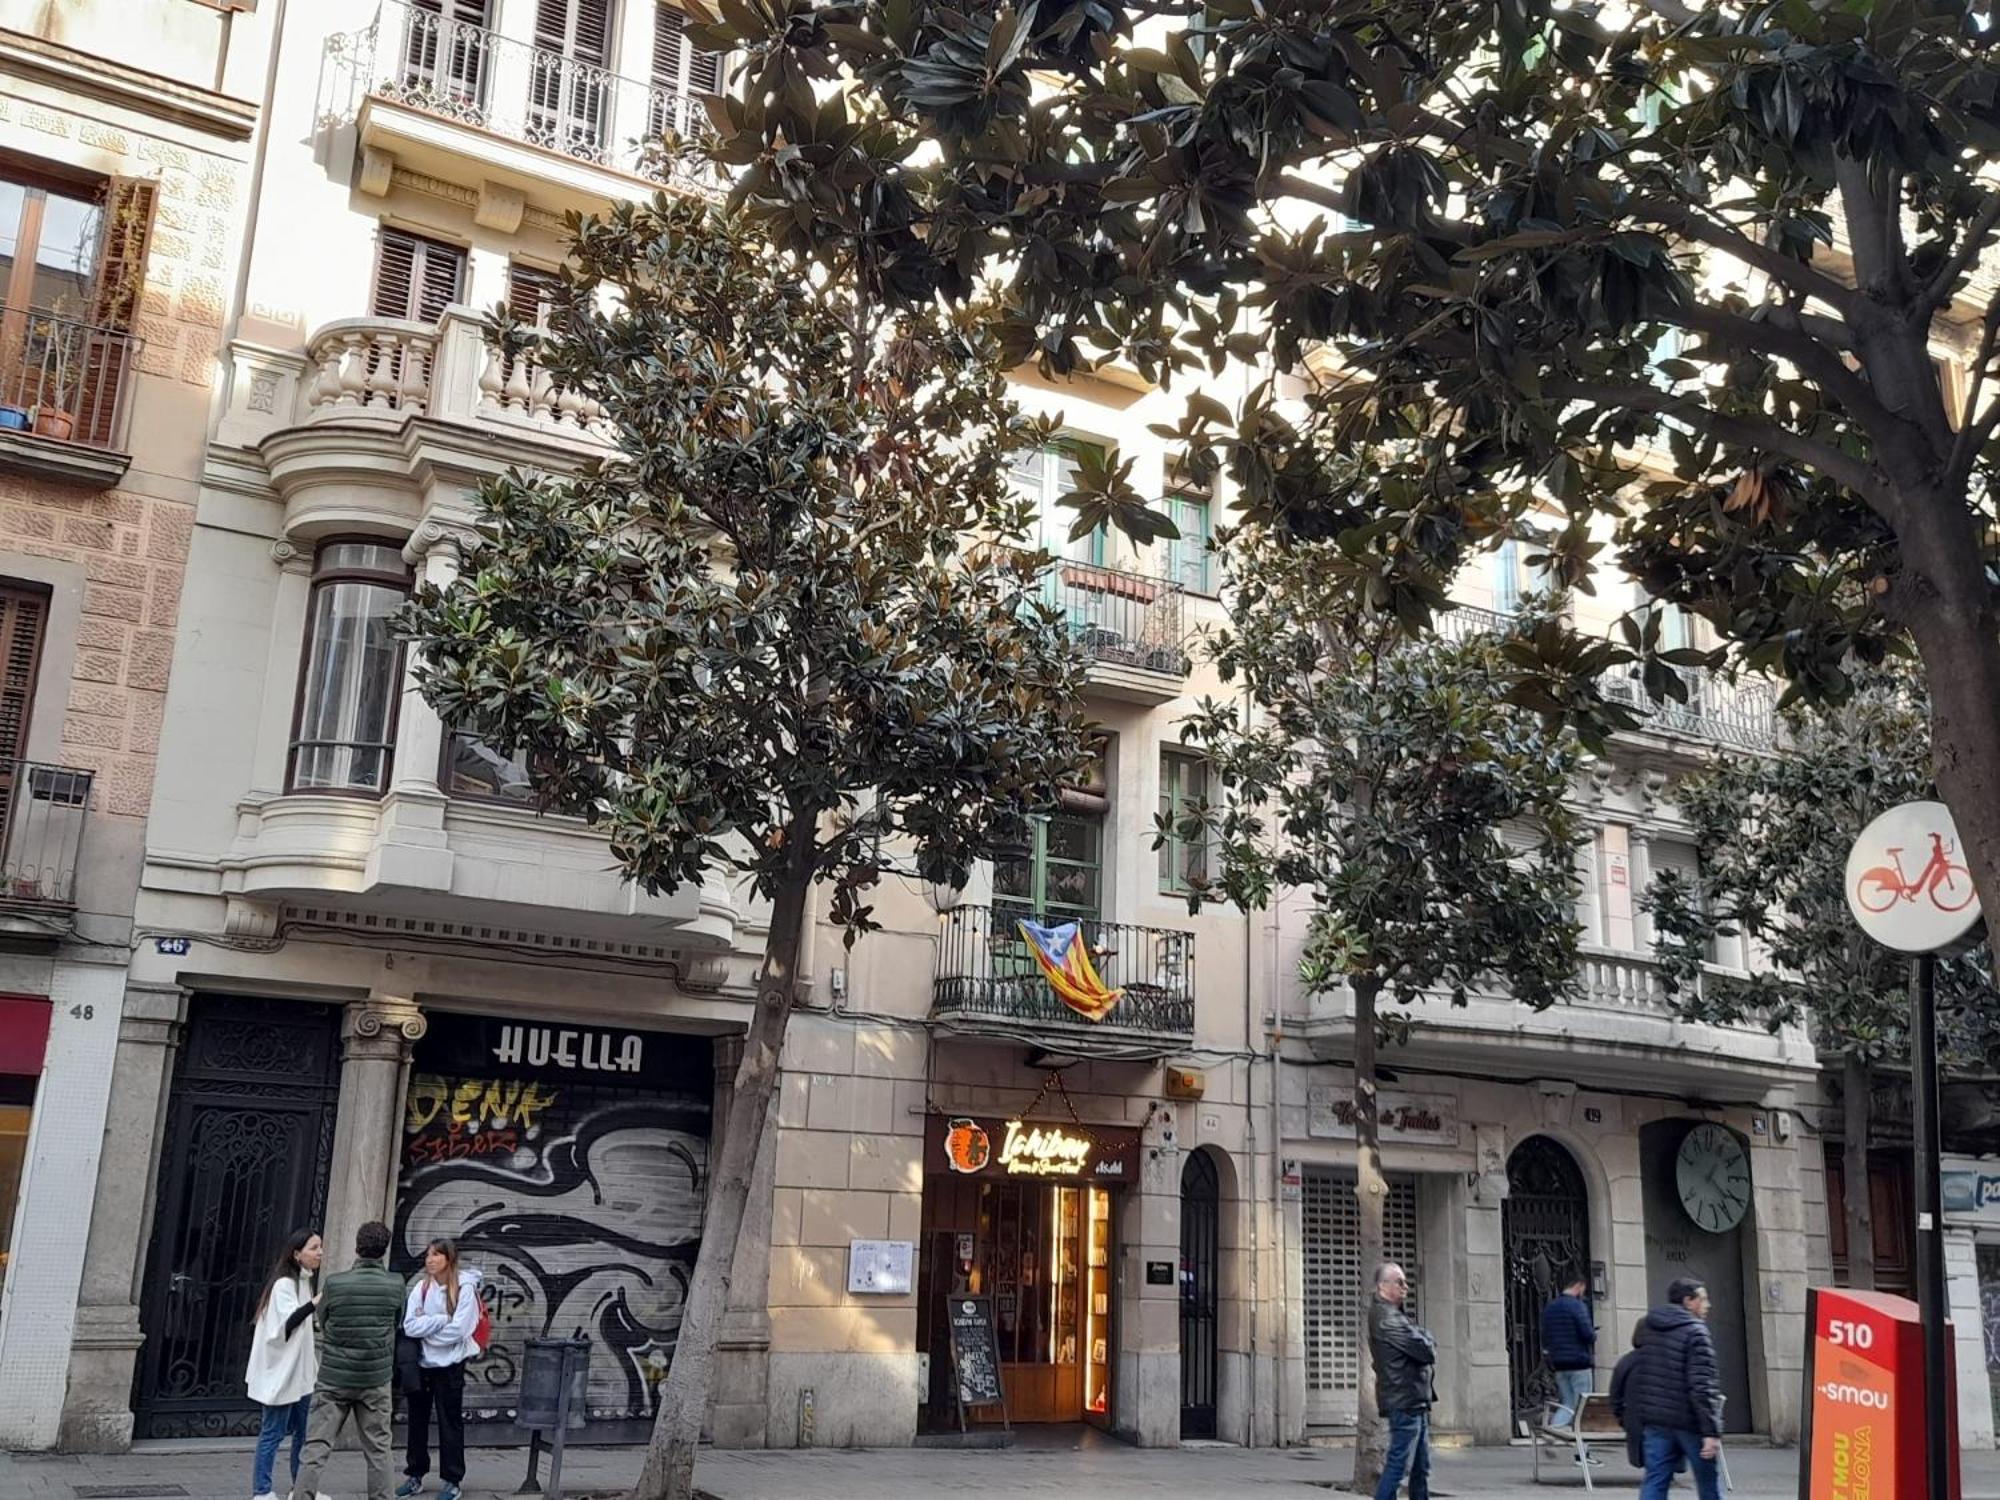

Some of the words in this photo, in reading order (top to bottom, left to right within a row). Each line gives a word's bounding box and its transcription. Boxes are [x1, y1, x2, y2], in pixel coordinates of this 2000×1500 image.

[160, 939, 184, 953] 46
[70, 1004, 94, 1020] 48
[493, 1025, 643, 1072] HUELLA
[998, 1121, 1090, 1164] Ichiban
[1828, 1320, 1873, 1348] 510
[1827, 1382, 1888, 1409] smou
